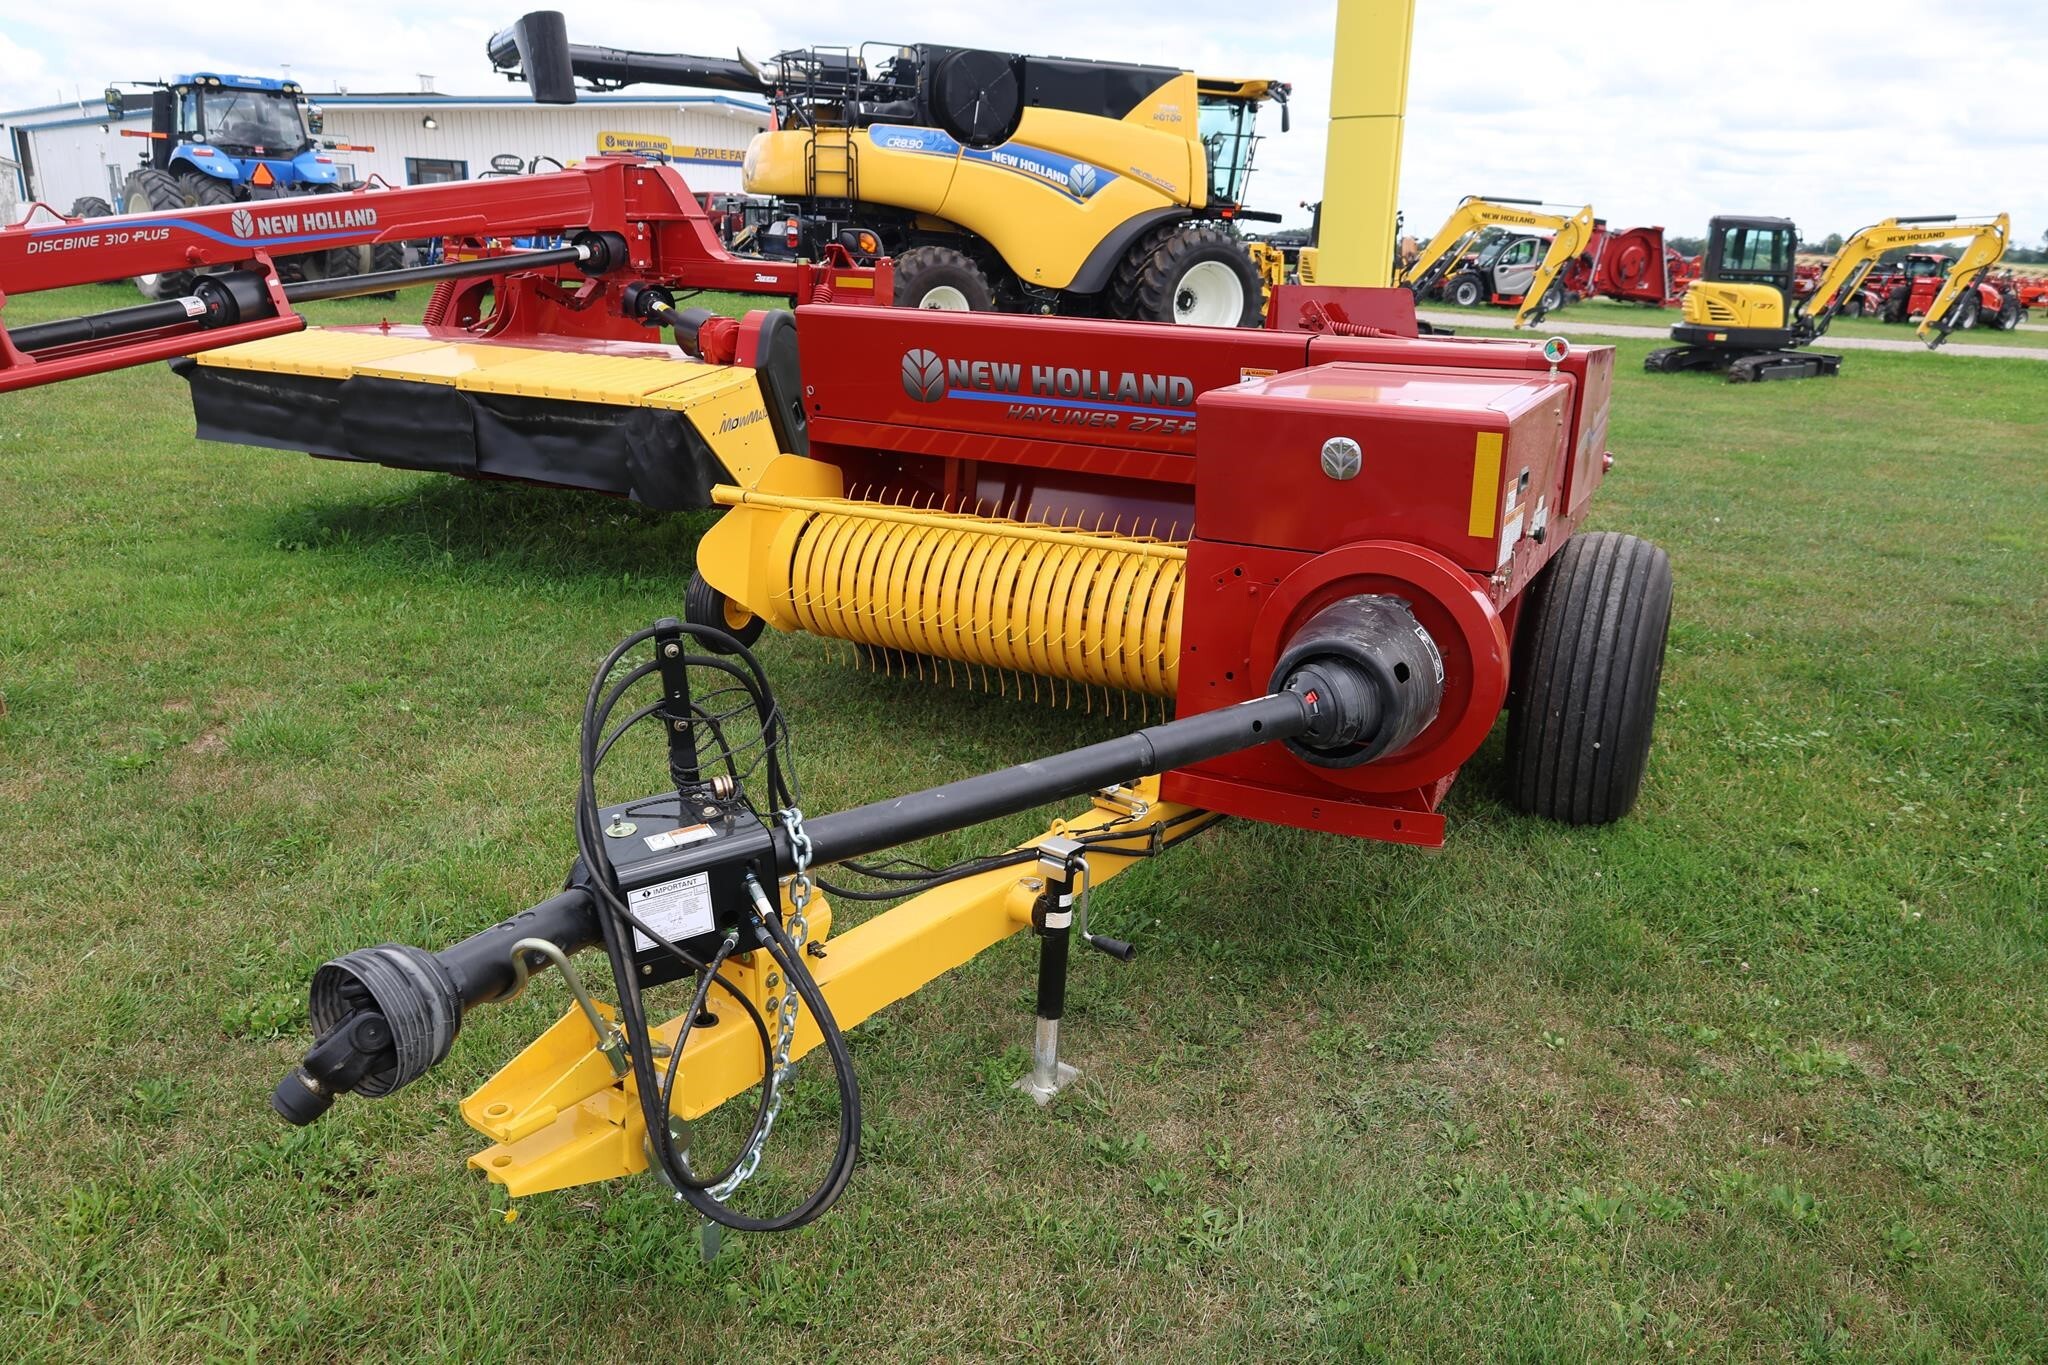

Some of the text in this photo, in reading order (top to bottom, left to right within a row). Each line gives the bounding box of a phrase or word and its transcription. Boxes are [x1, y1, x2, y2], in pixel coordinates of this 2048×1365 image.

[616, 139, 668, 150] NEW HOLLAND
[887, 137, 924, 149] CR8.90
[694, 147, 727, 160] APPLE
[991, 151, 1069, 185] NEW HOLLAND
[257, 208, 377, 235] NEW HOLLAND
[1481, 212, 1536, 224] NEW HOLLAND
[27, 235, 100, 254] DISCBINE
[104, 233, 129, 245] 310
[1887, 231, 1945, 242] NEW HOLLAND
[948, 358, 1194, 407] NEW HOLLAND
[1007, 404, 1120, 428] HAYLINER
[653, 878, 697, 896] IMPORTANT
